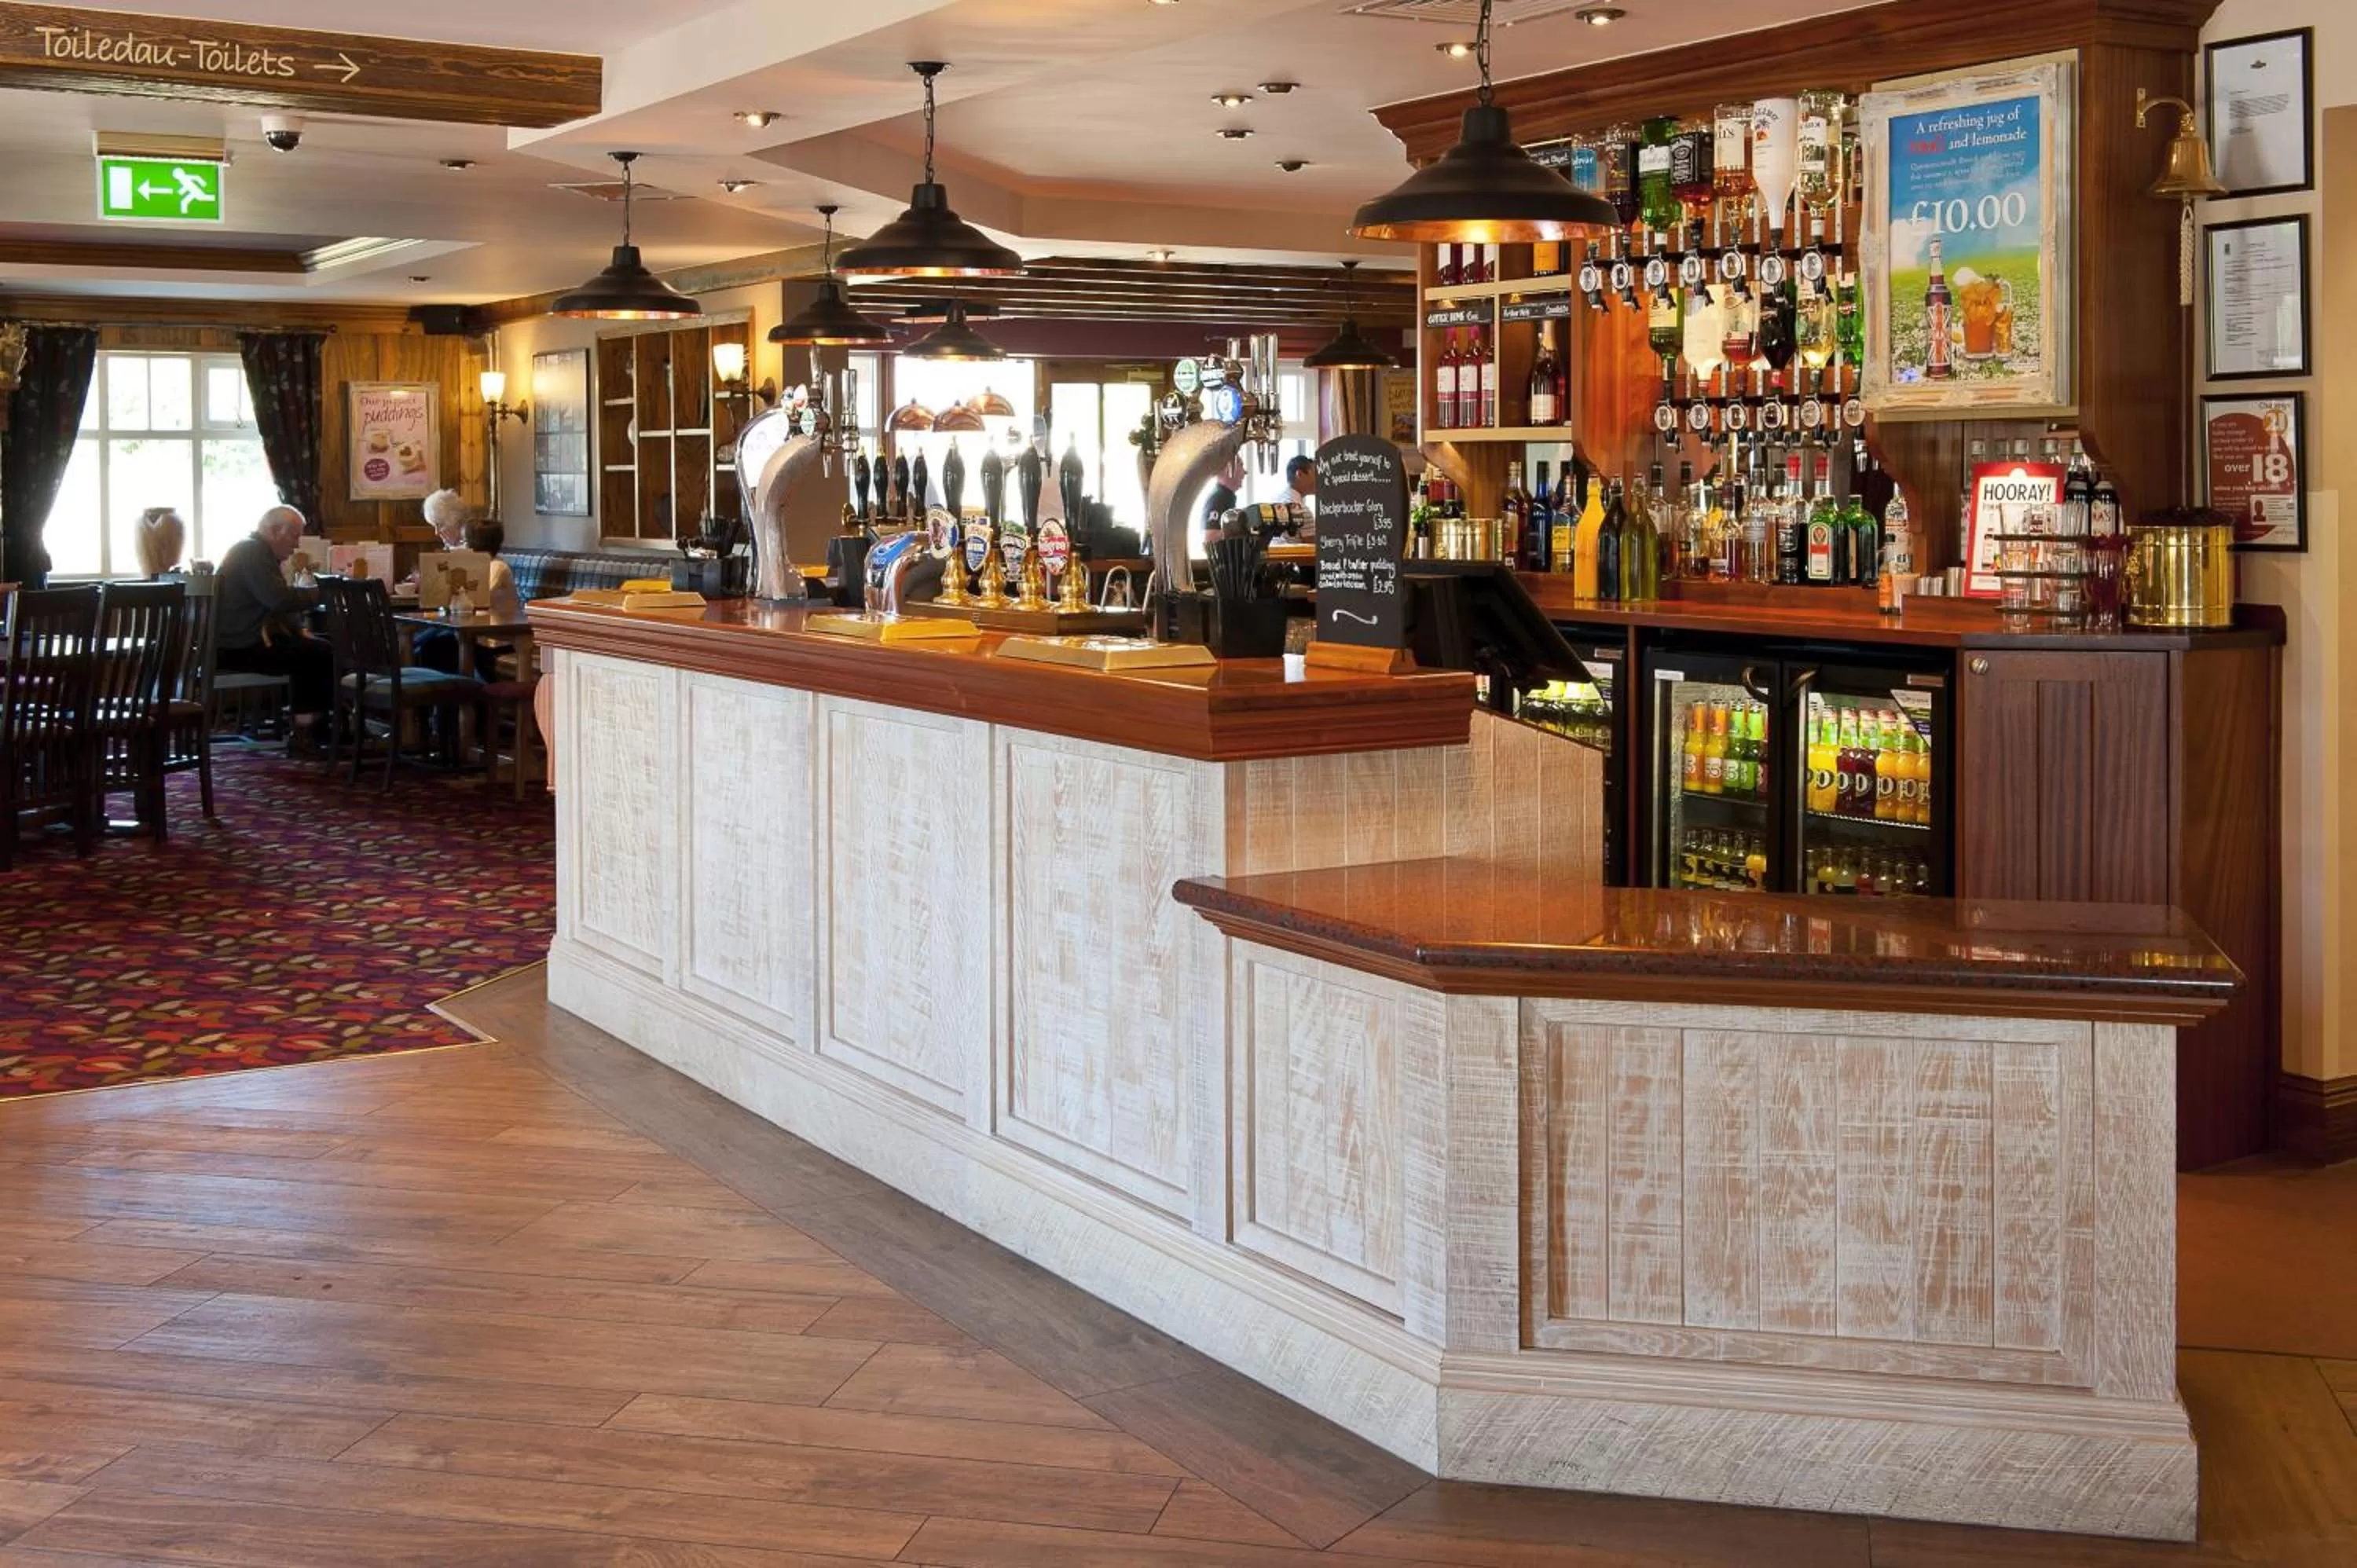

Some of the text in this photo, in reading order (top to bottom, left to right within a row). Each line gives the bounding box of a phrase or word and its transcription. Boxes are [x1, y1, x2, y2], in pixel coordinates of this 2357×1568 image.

[1915, 104, 2022, 134] A refreshing jug of
[1948, 134, 1968, 150] and
[1971, 126, 2028, 147] lemonade
[1909, 192, 2027, 234] £10.00
[2224, 453, 2289, 484] over 18
[1983, 483, 2053, 502] HOORAY!
